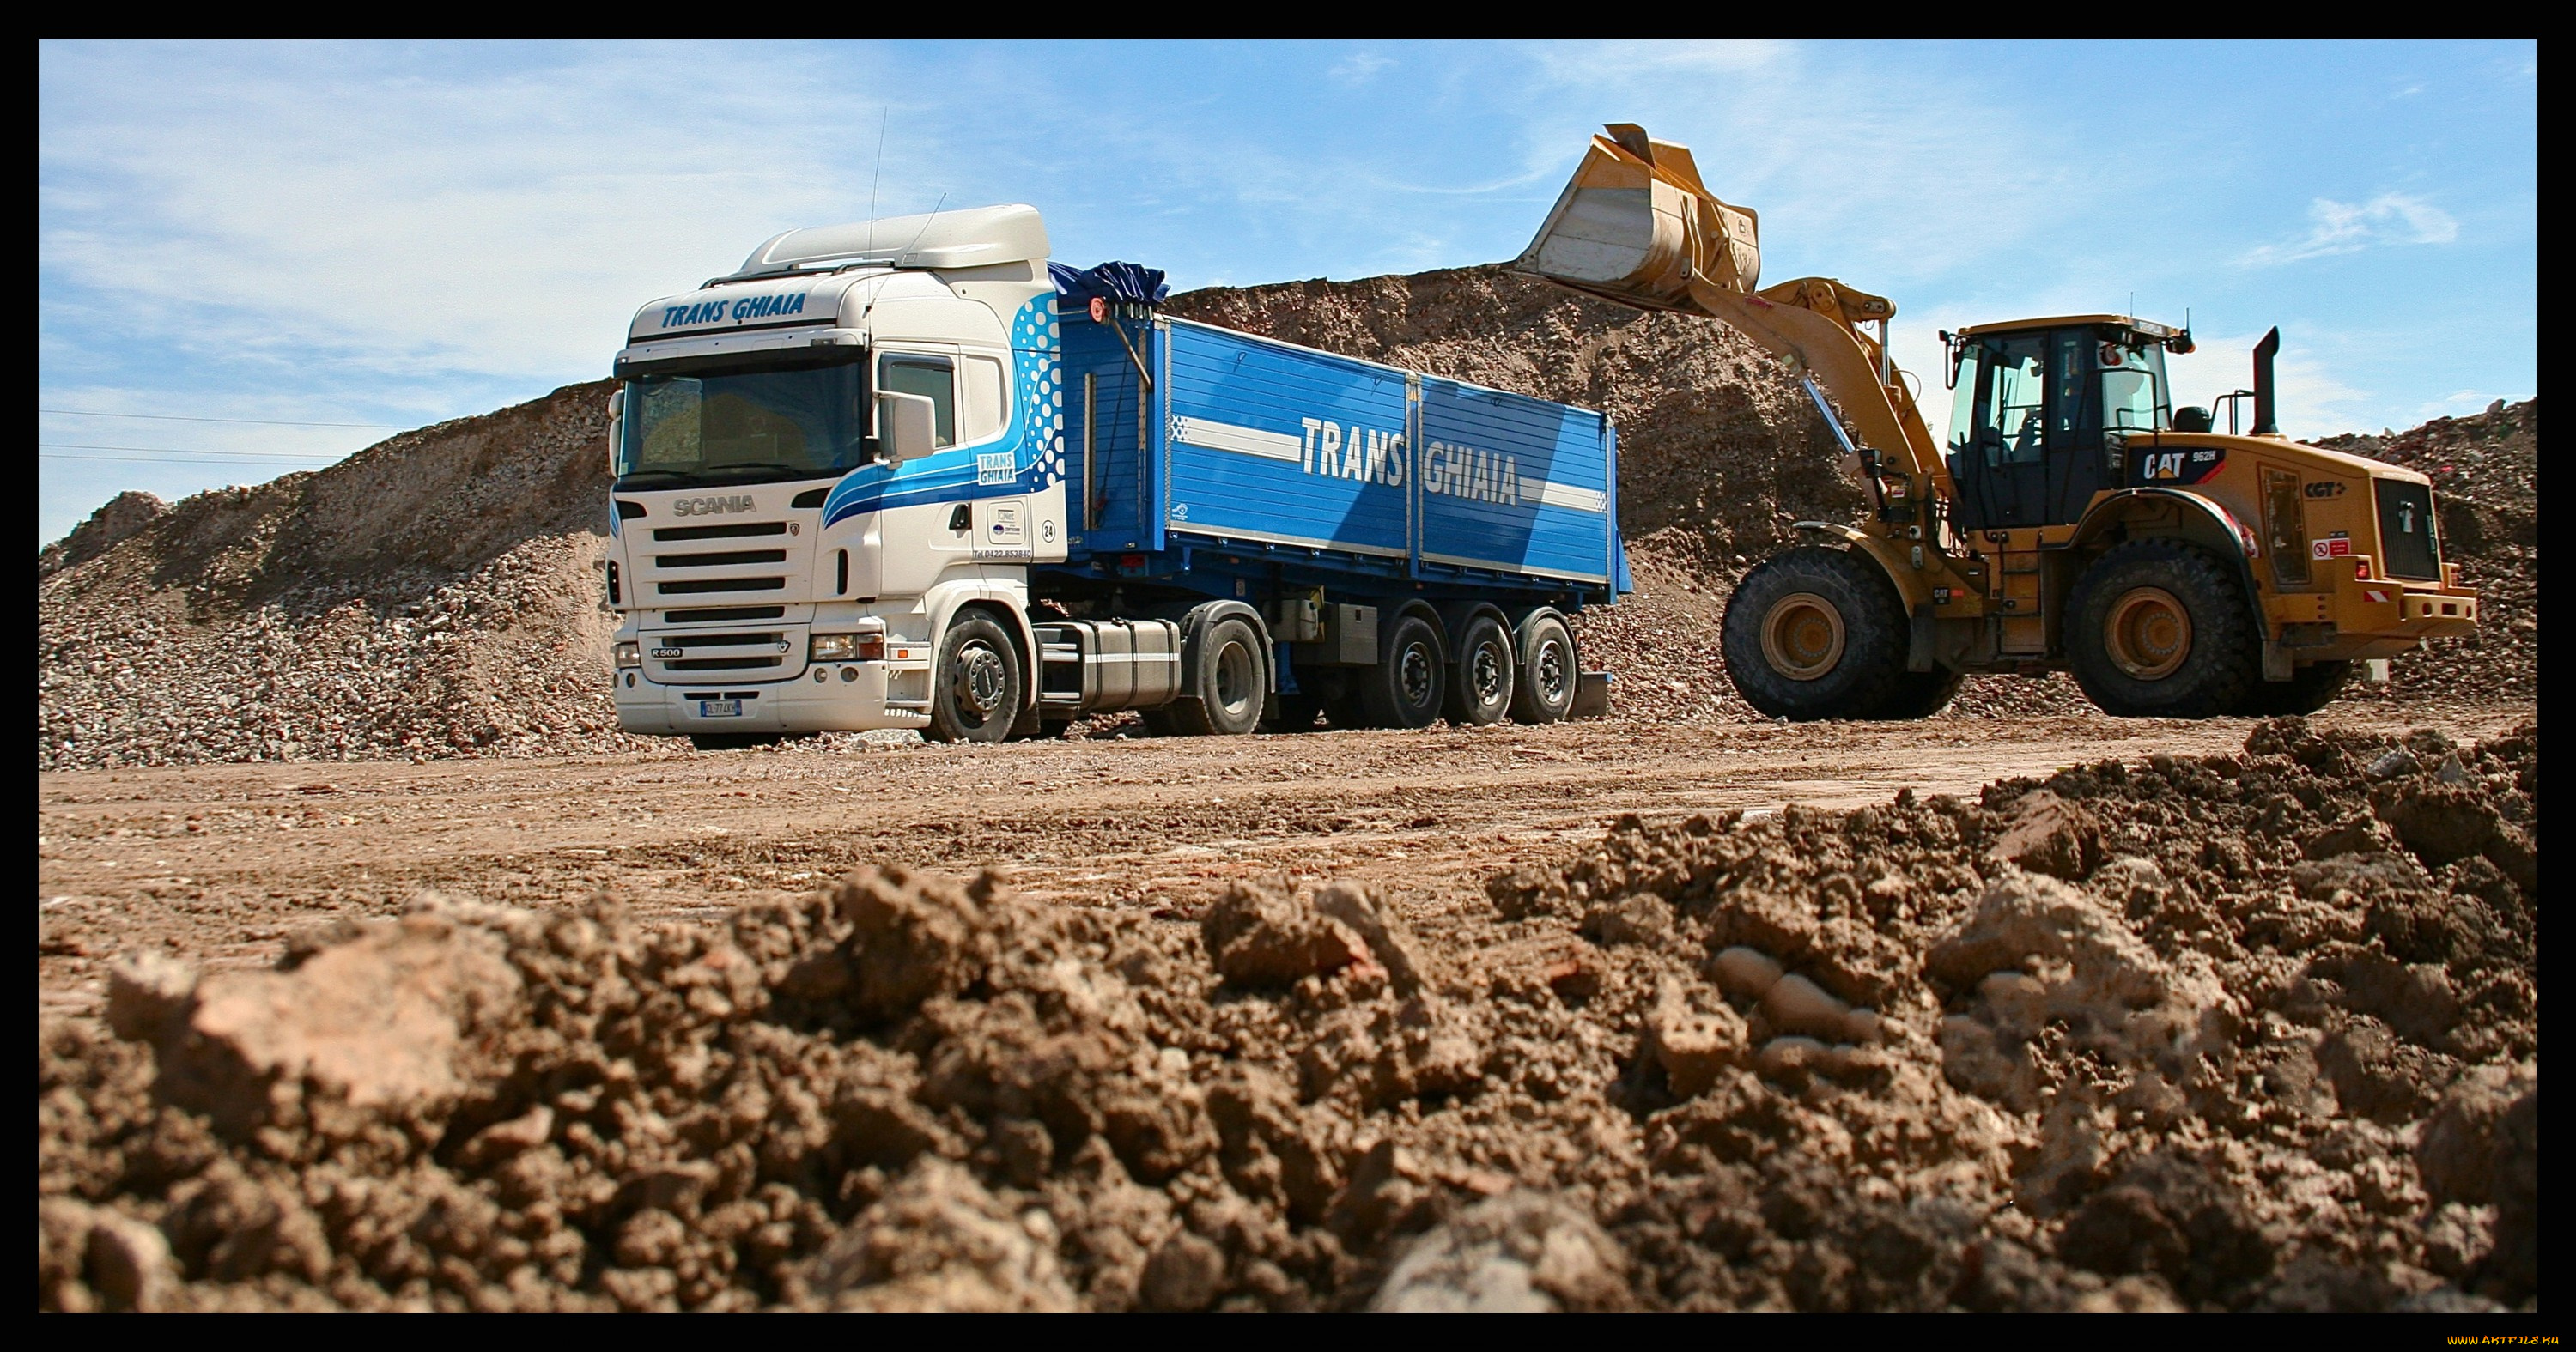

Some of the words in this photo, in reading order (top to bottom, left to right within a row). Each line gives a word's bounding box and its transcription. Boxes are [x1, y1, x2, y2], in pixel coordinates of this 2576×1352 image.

[662, 300, 730, 329] TRANS
[732, 293, 806, 320] GHIAIA
[980, 454, 1012, 469] TRANS
[1302, 416, 1405, 487] TRANS
[1424, 440, 1517, 506] GHIAIA
[2143, 452, 2185, 479] CAT
[2192, 450, 2216, 463] 962H
[980, 468, 1014, 483] GHIAIA
[673, 494, 757, 517] SCANIA
[1044, 525, 1054, 537] 24
[1934, 589, 1948, 598] CAT
